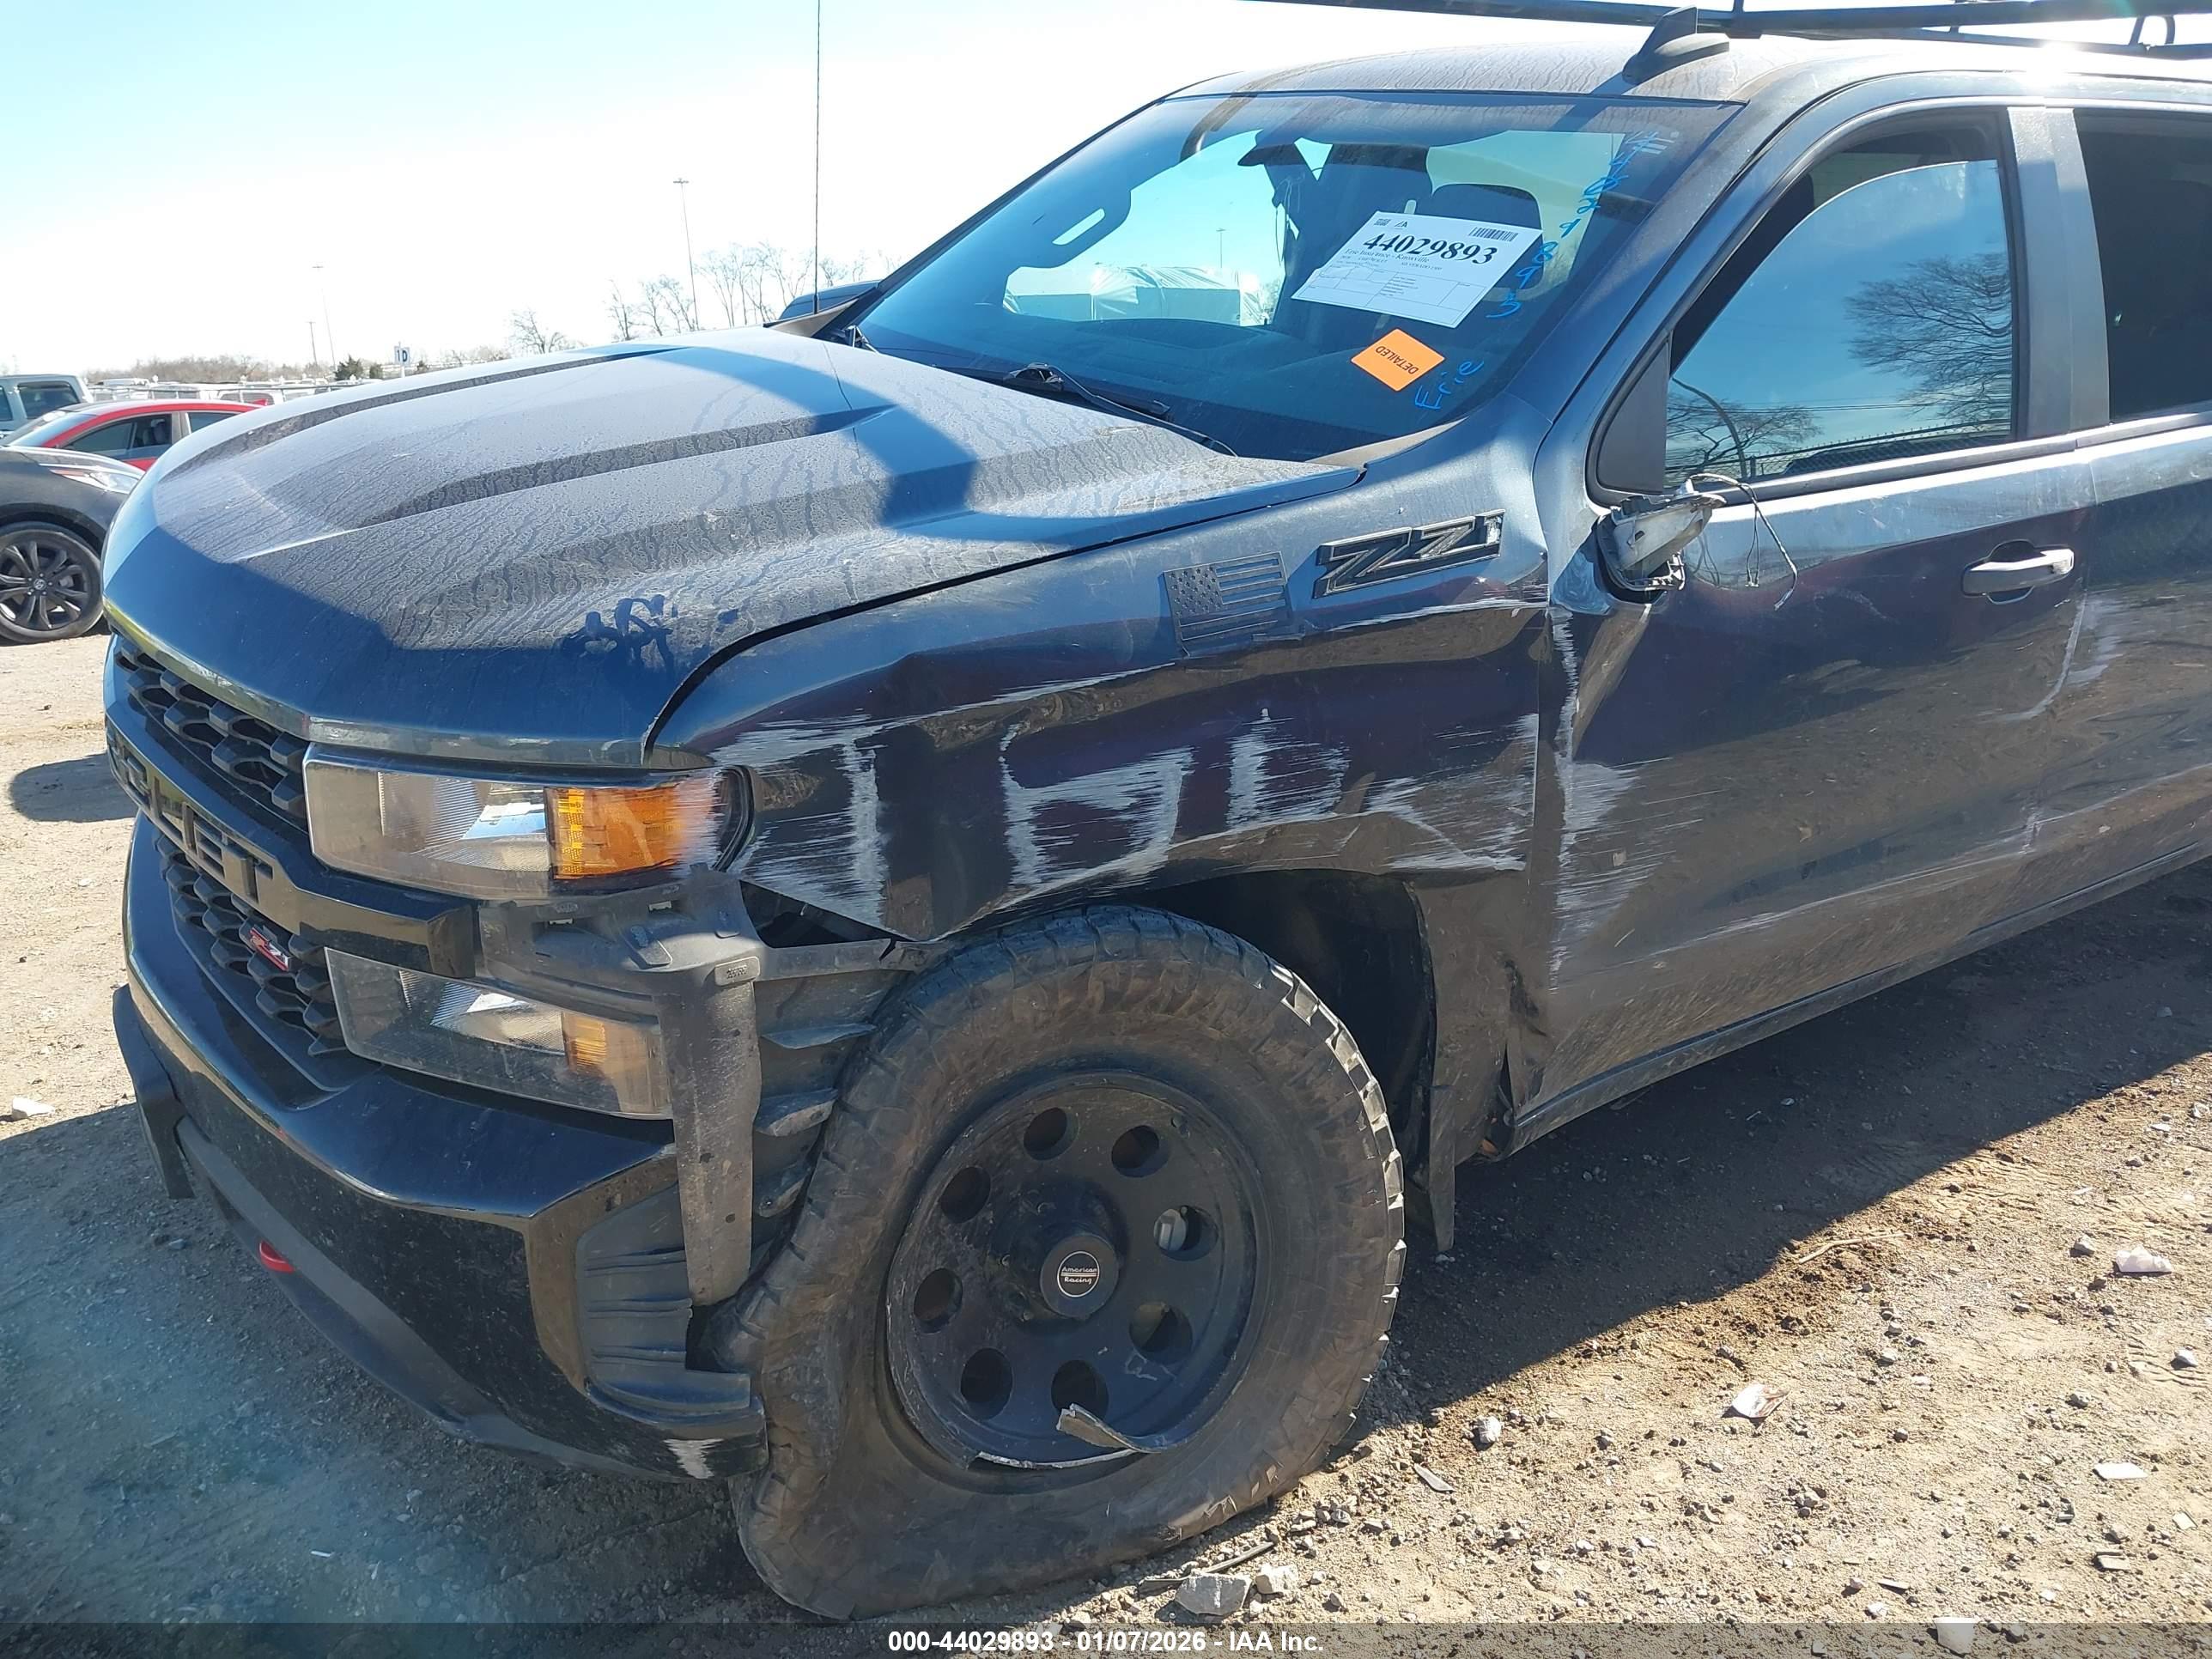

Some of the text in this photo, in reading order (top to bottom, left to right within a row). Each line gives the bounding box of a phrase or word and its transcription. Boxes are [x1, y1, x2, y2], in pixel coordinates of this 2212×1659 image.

[1363, 233, 1498, 264] 44029893
[1375, 345, 1419, 375] DETAILED
[1414, 360, 1485, 410] Erie
[1064, 1276, 1092, 1285] Racing
